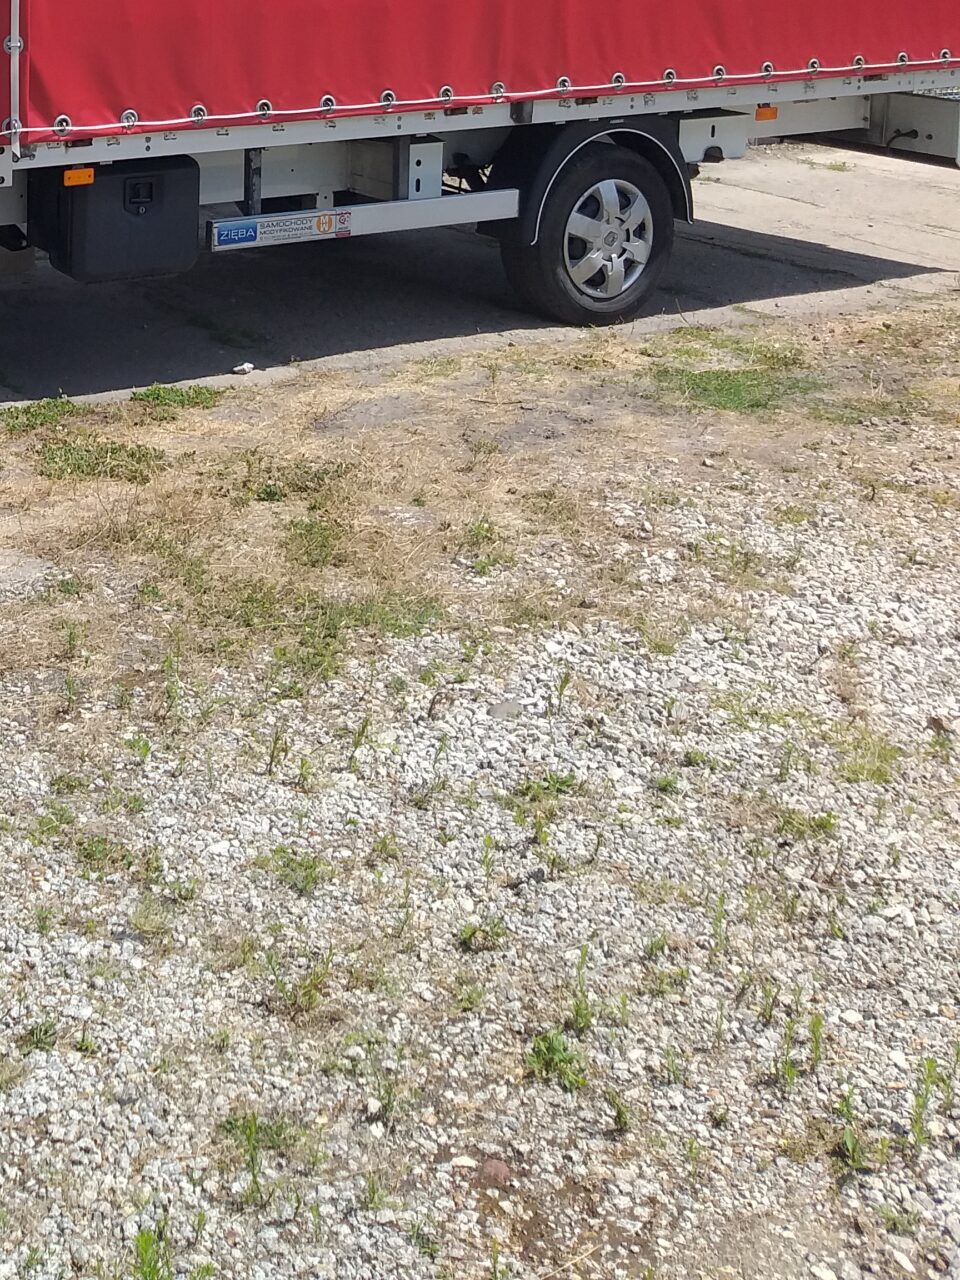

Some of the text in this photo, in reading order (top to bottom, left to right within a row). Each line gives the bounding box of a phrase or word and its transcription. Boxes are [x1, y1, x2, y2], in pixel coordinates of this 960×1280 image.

[259, 218, 313, 230] SAMOCHODY
[220, 228, 255, 241] ZIĘBA
[259, 225, 313, 236] MODYFIKOWANE
